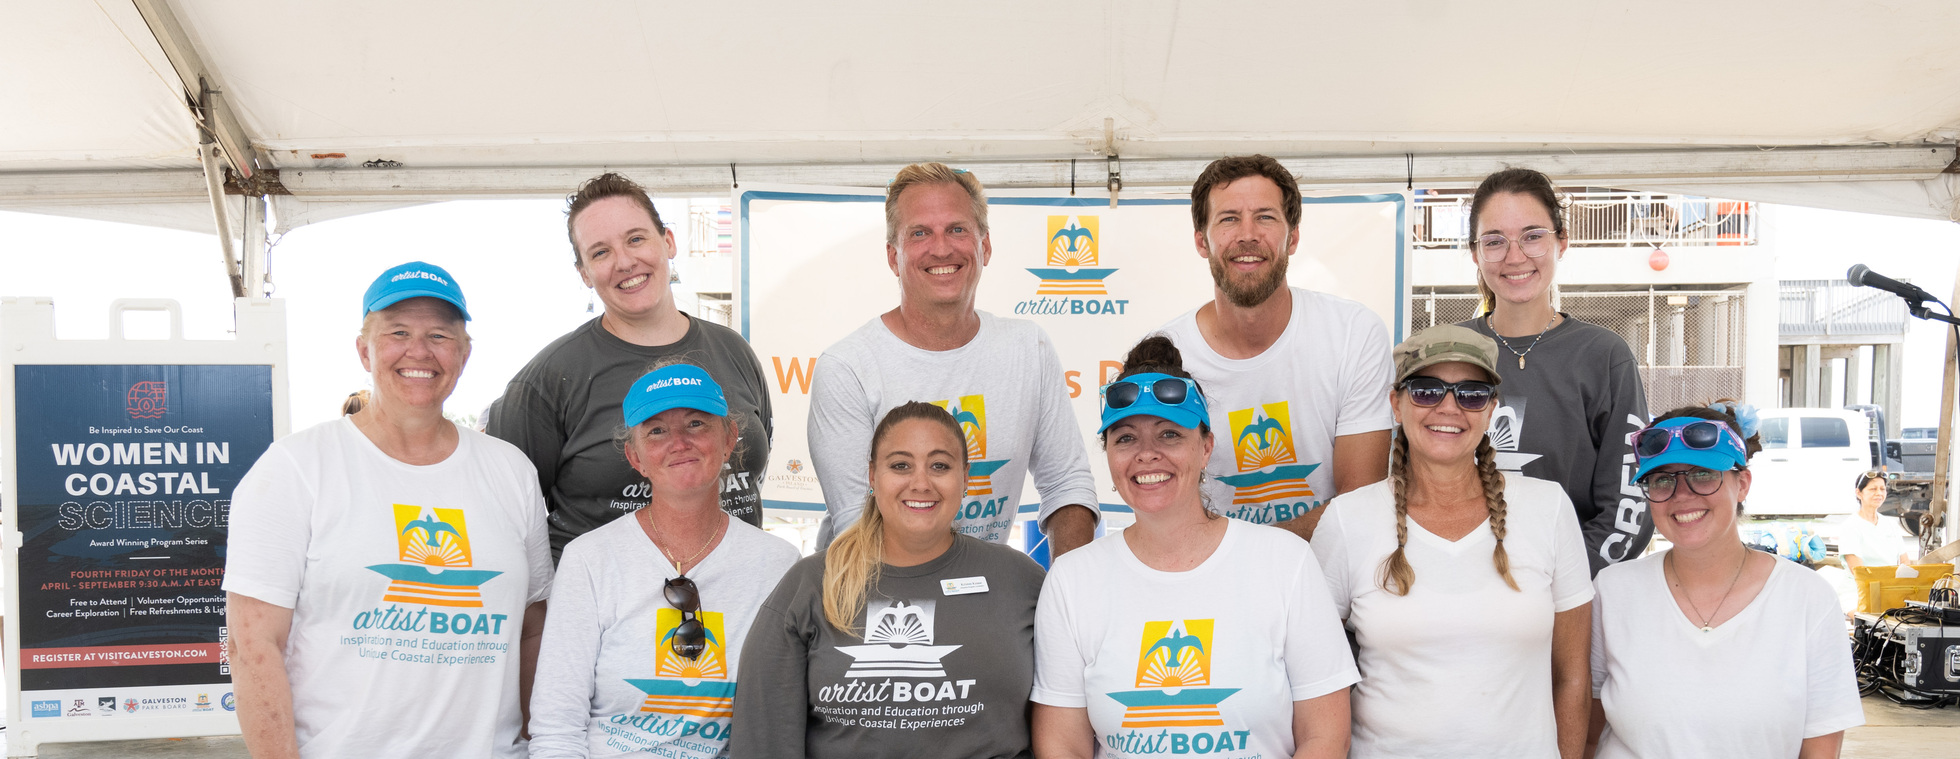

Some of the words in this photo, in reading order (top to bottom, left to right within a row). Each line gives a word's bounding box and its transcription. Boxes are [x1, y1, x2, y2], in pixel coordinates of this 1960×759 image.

[102, 426, 132, 436] Inspired
[144, 426, 162, 434] Save
[182, 426, 204, 434] Coast
[52, 442, 188, 466] WOMEN
[196, 442, 230, 464] IN
[65, 472, 220, 496] COASTAL
[58, 500, 231, 531] SCIENCE
[90, 539, 114, 547] Award
[116, 538, 149, 548] Winning
[151, 538, 184, 548] Program
[70, 570, 112, 579] FOURTH
[115, 570, 152, 578] FRIDAY
[153, 569, 167, 577] OF
[168, 568, 188, 576] THE
[40, 582, 70, 591] APRIL
[79, 580, 136, 590] SEPTEMBER
[138, 580, 158, 588] 9:30
[160, 580, 182, 588] A.M.
[198, 578, 221, 586] EAST
[70, 598, 88, 606] Free
[100, 598, 128, 606] Attend
[137, 597, 175, 605] Volunteer
[176, 596, 226, 606] Opportunitie
[46, 610, 73, 618] Career
[75, 608, 120, 619] Exploration
[130, 608, 147, 616] Free
[149, 607, 202, 616] Refreshments
[213, 606, 226, 616] Ligh
[340, 635, 392, 646] Inspiration
[396, 638, 418, 648] and
[422, 638, 475, 651] Education
[477, 640, 508, 653] throug
[32, 654, 82, 663] REGISTER
[84, 653, 96, 661] AT
[98, 650, 208, 662] VISITGALVESTON.COM
[391, 650, 434, 664] Coastal
[437, 654, 496, 666] Experiences
[814, 704, 858, 716] Inspiration
[861, 706, 881, 716] and
[884, 704, 938, 717] Education
[942, 701, 984, 716] through
[826, 714, 856, 726] Unique
[859, 718, 896, 729] Coastal
[900, 716, 965, 730] Experiences
